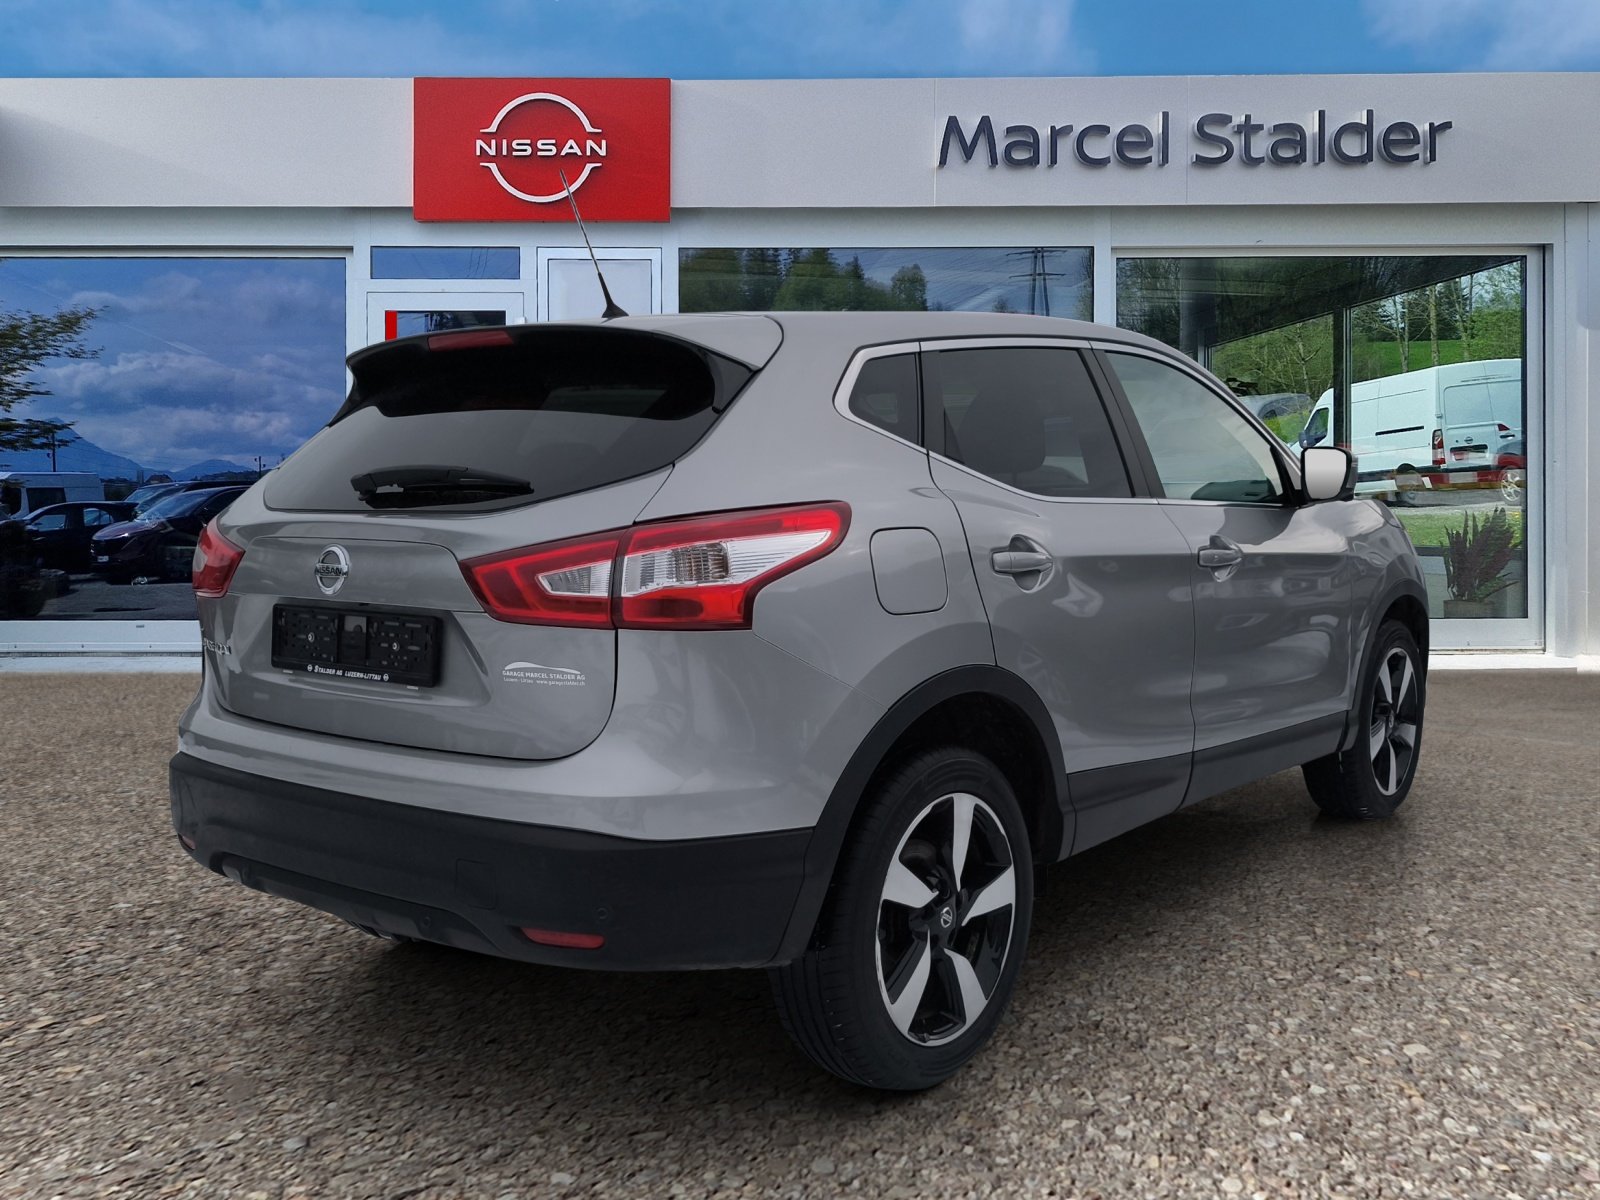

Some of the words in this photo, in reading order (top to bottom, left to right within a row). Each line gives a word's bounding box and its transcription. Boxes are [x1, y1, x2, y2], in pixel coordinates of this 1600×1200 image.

[475, 138, 607, 157] NISSAN
[937, 110, 1170, 168] Marcel
[1191, 108, 1454, 165] Stalder
